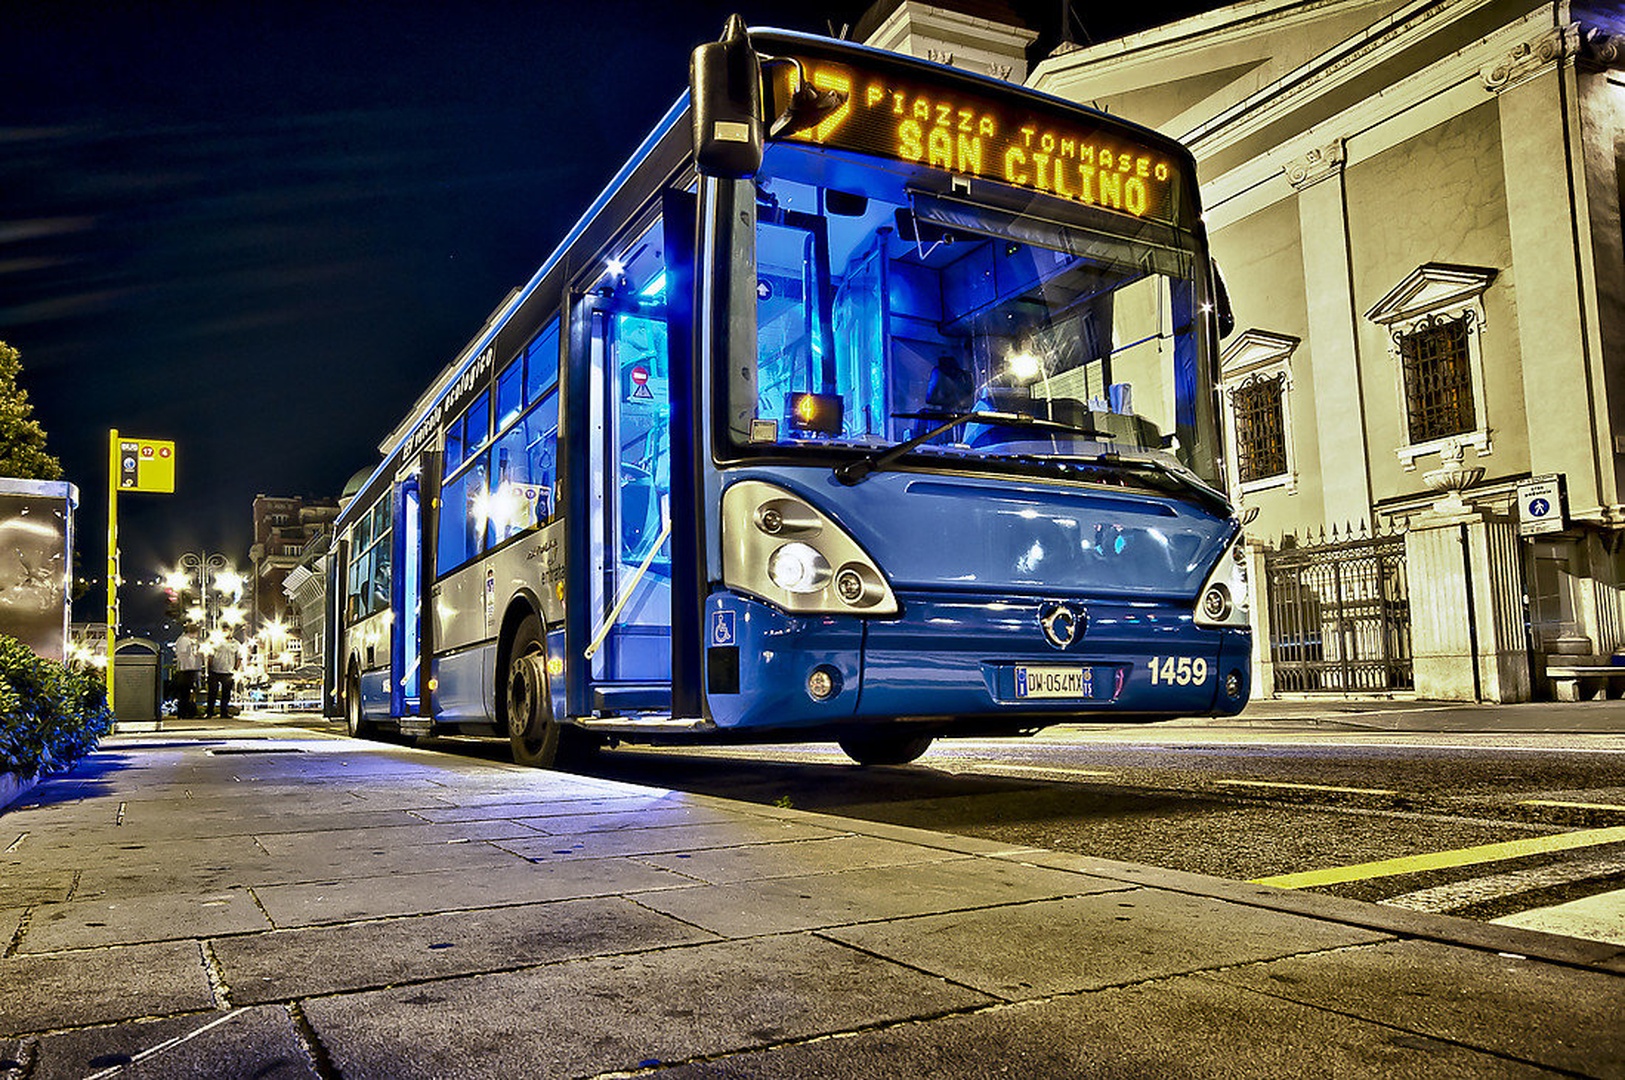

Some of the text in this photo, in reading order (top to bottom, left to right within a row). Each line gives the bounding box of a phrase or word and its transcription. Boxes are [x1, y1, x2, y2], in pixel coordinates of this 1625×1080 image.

[867, 85, 1168, 182] PIAZZA TOMMASEO
[898, 118, 1148, 217] SAN CILINO
[142, 448, 153, 456] 17
[161, 449, 169, 457] 4
[1148, 656, 1208, 686] 1459
